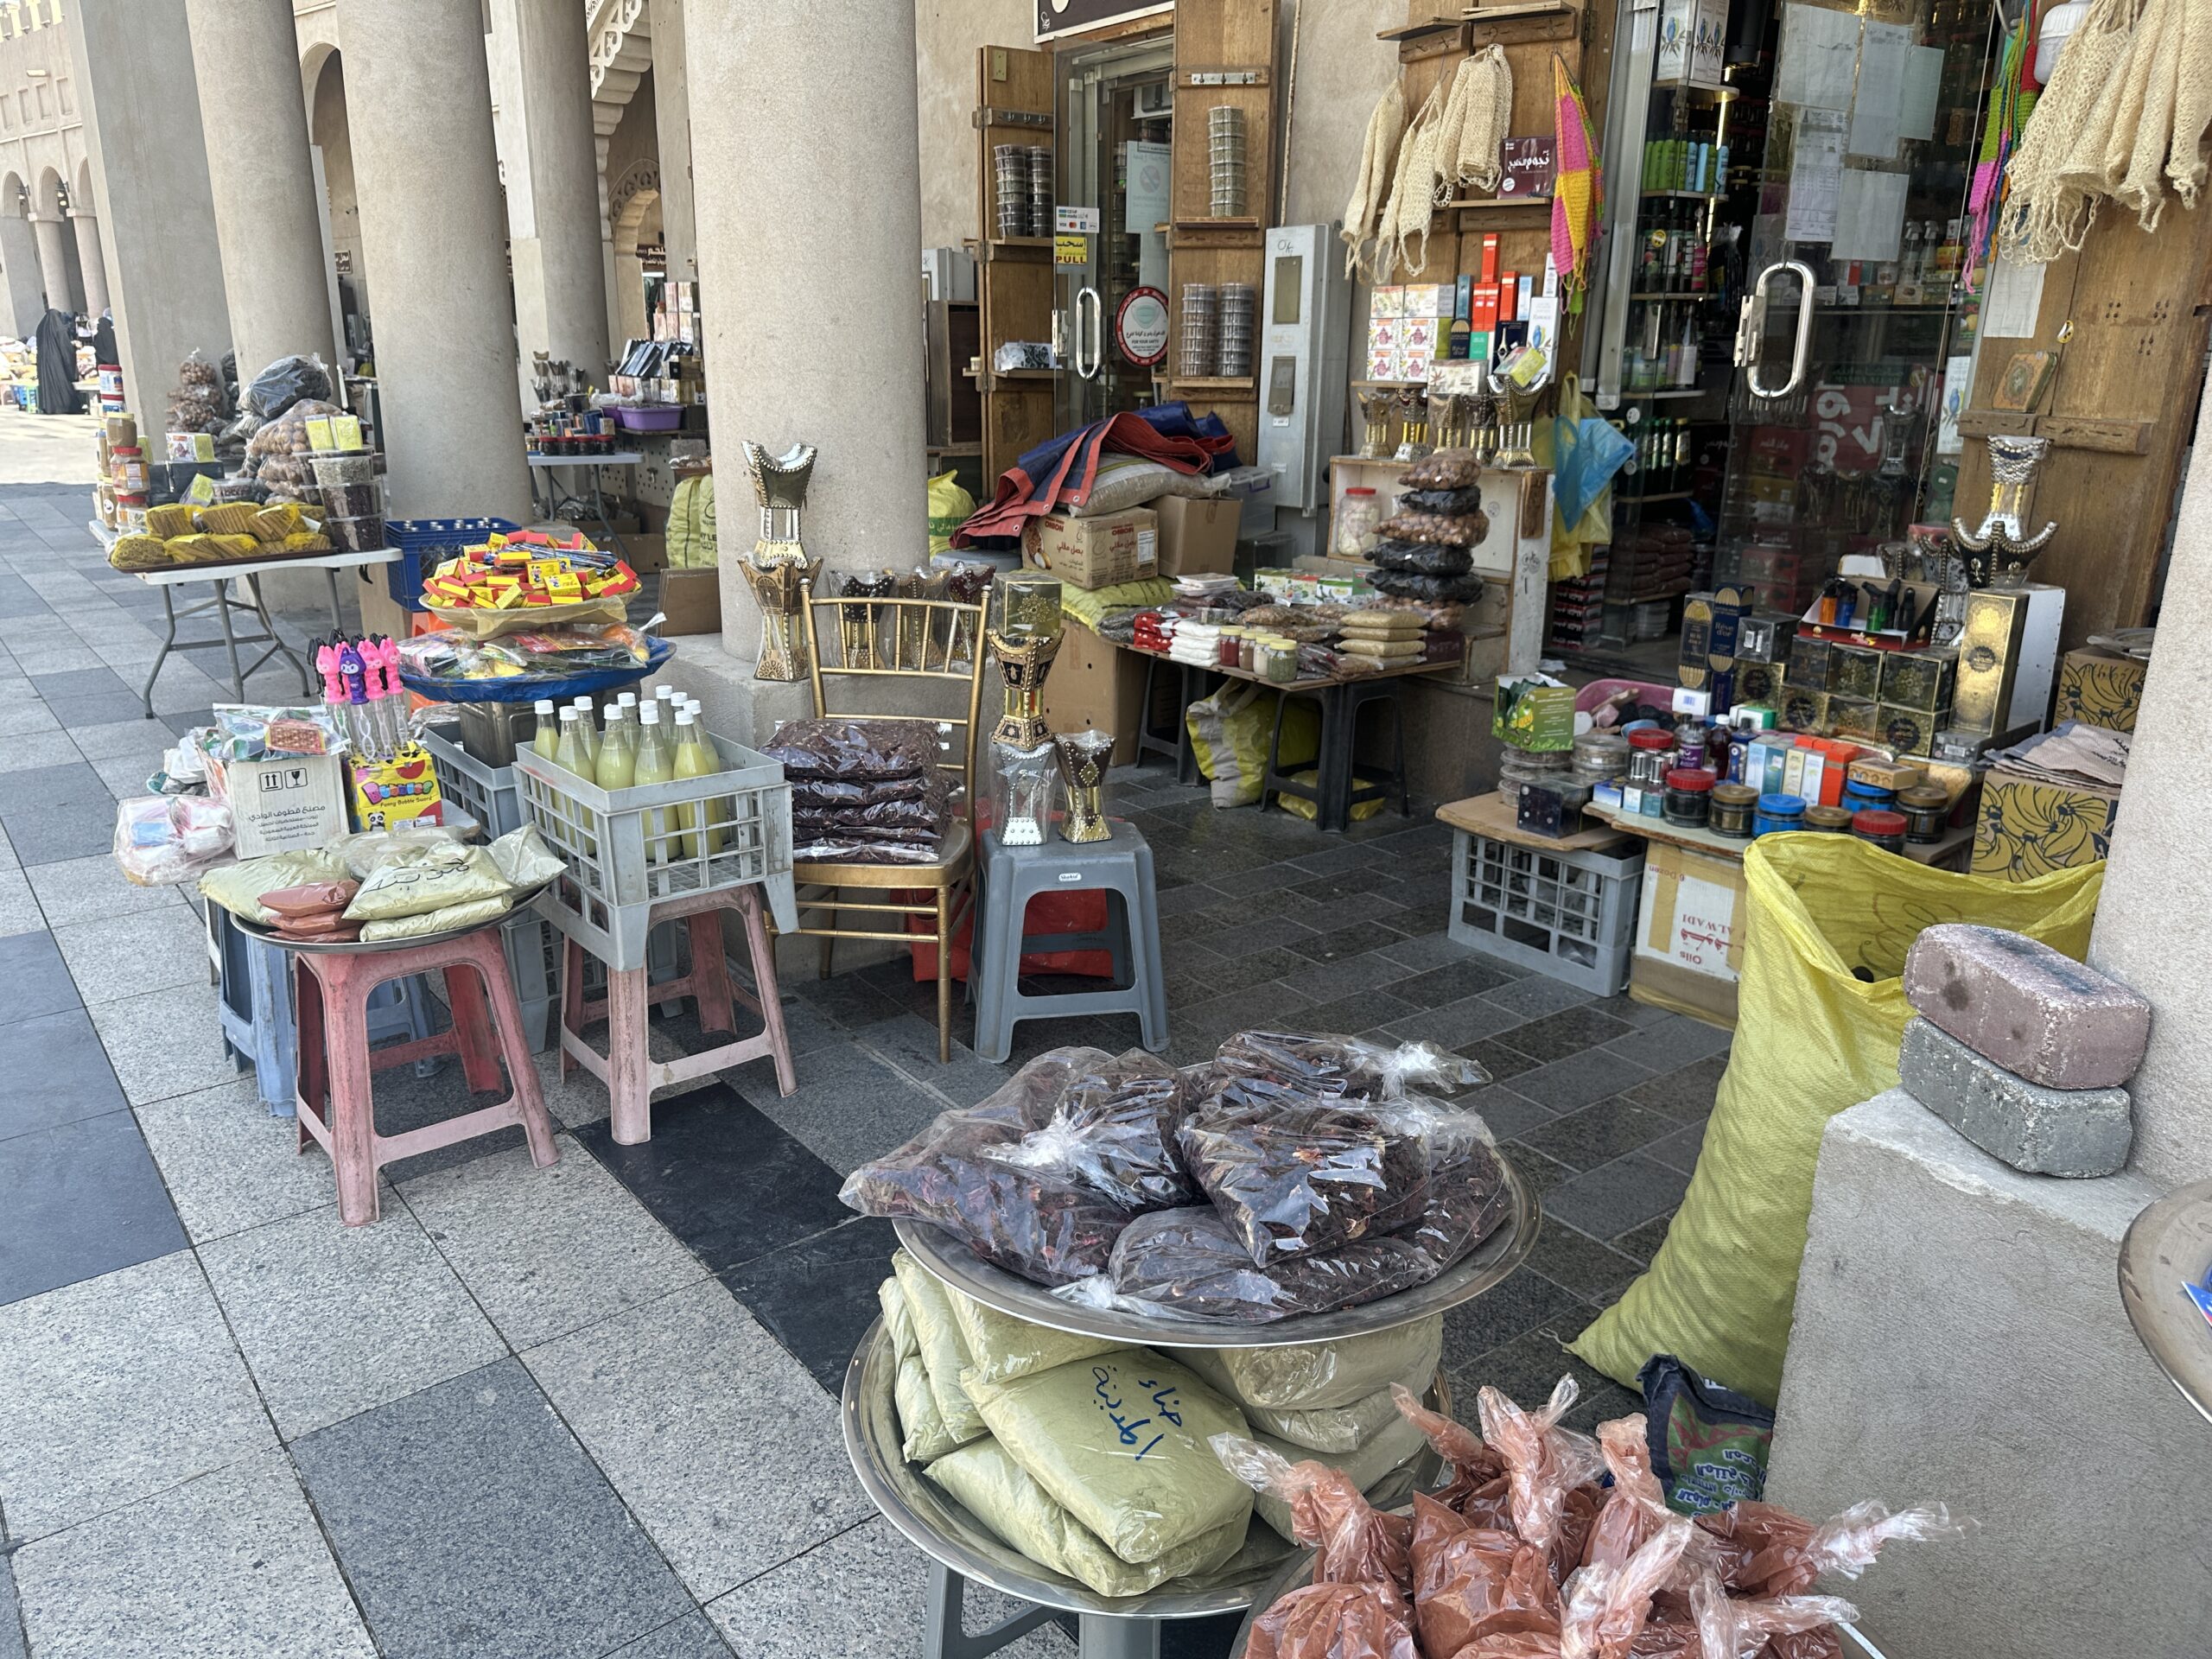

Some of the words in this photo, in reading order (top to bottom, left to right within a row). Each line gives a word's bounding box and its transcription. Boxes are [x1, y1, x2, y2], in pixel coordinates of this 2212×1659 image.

[1045, 520, 1065, 532] ONION
[1111, 527, 1135, 536] ONION
[1057, 541, 1071, 553] مقلي
[1071, 544, 1084, 556] بصل
[361, 779, 434, 805] Bubbles
[273, 806, 301, 817] قطوف
[302, 804, 326, 814] مصنع
[248, 811, 273, 823] الوادي
[1648, 865, 1677, 880] Dozen
[1679, 873, 1686, 882] 6
[1679, 950, 1702, 965] Oils
[1694, 1464, 1738, 1482] المنتج
